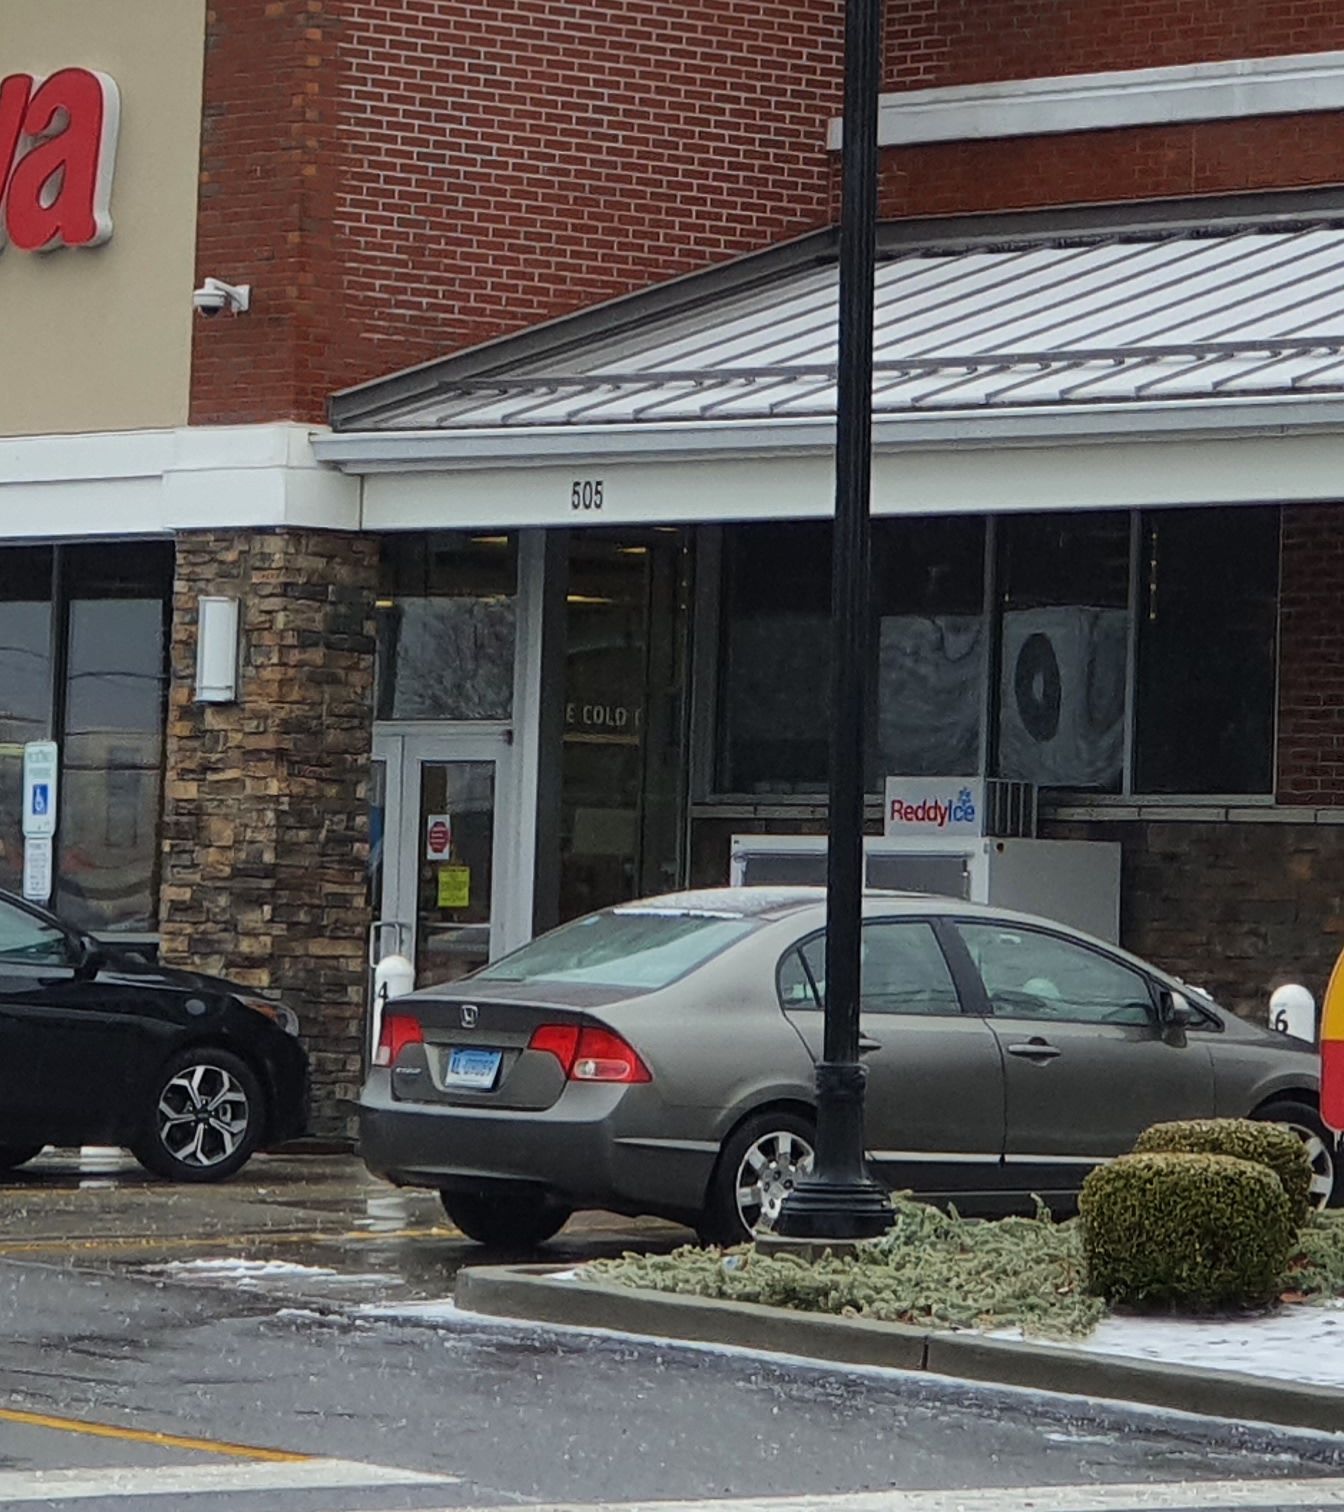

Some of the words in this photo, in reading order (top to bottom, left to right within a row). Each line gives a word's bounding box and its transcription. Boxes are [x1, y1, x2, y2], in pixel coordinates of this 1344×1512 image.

[571, 480, 604, 510] 505
[582, 704, 627, 726] COLD
[377, 980, 389, 1001] 4
[1274, 1008, 1289, 1034] 6
